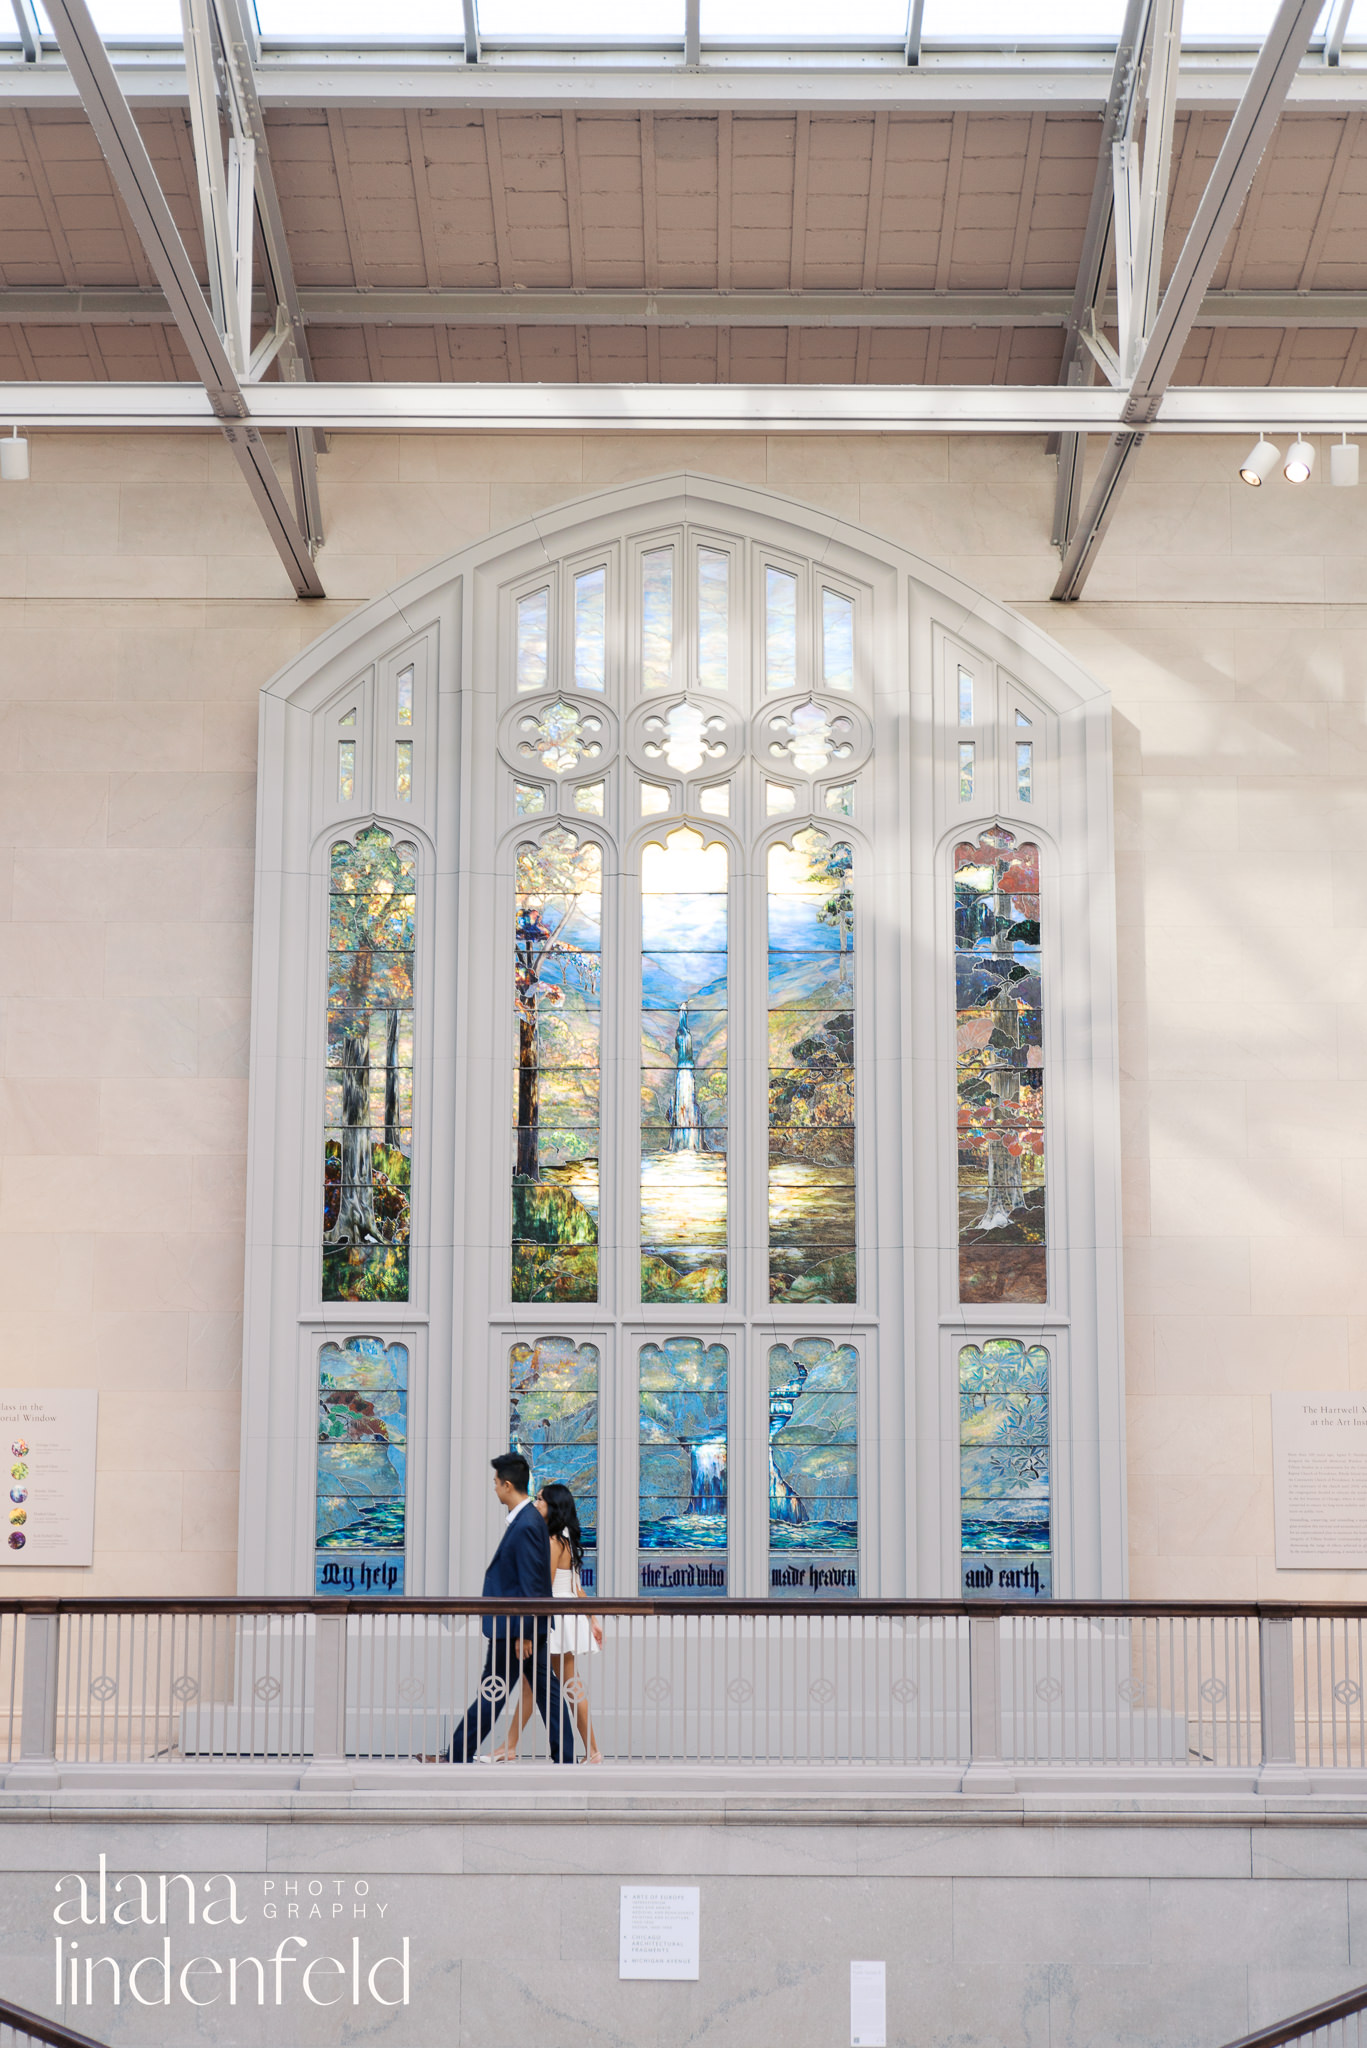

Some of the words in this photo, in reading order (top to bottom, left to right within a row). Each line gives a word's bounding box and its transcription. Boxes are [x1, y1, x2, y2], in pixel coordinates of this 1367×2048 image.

[0, 1403, 16, 1411] lass
[19, 1403, 28, 1411] in
[31, 1403, 44, 1411] the
[1302, 1405, 1317, 1414] The
[1320, 1405, 1358, 1414] Hartwell
[0, 1413, 19, 1422] orial
[23, 1413, 57, 1422] Window
[1321, 1418, 1333, 1426] the
[1336, 1418, 1350, 1426] Art
[1353, 1418, 1367, 1426] Inst
[321, 1562, 355, 1591] My
[360, 1560, 398, 1590] help
[660, 1563, 694, 1588] Lord
[695, 1562, 724, 1588] who
[771, 1564, 805, 1588] made
[809, 1564, 857, 1594] heaven
[965, 1563, 993, 1589] and
[999, 1561, 1045, 1596] earth.
